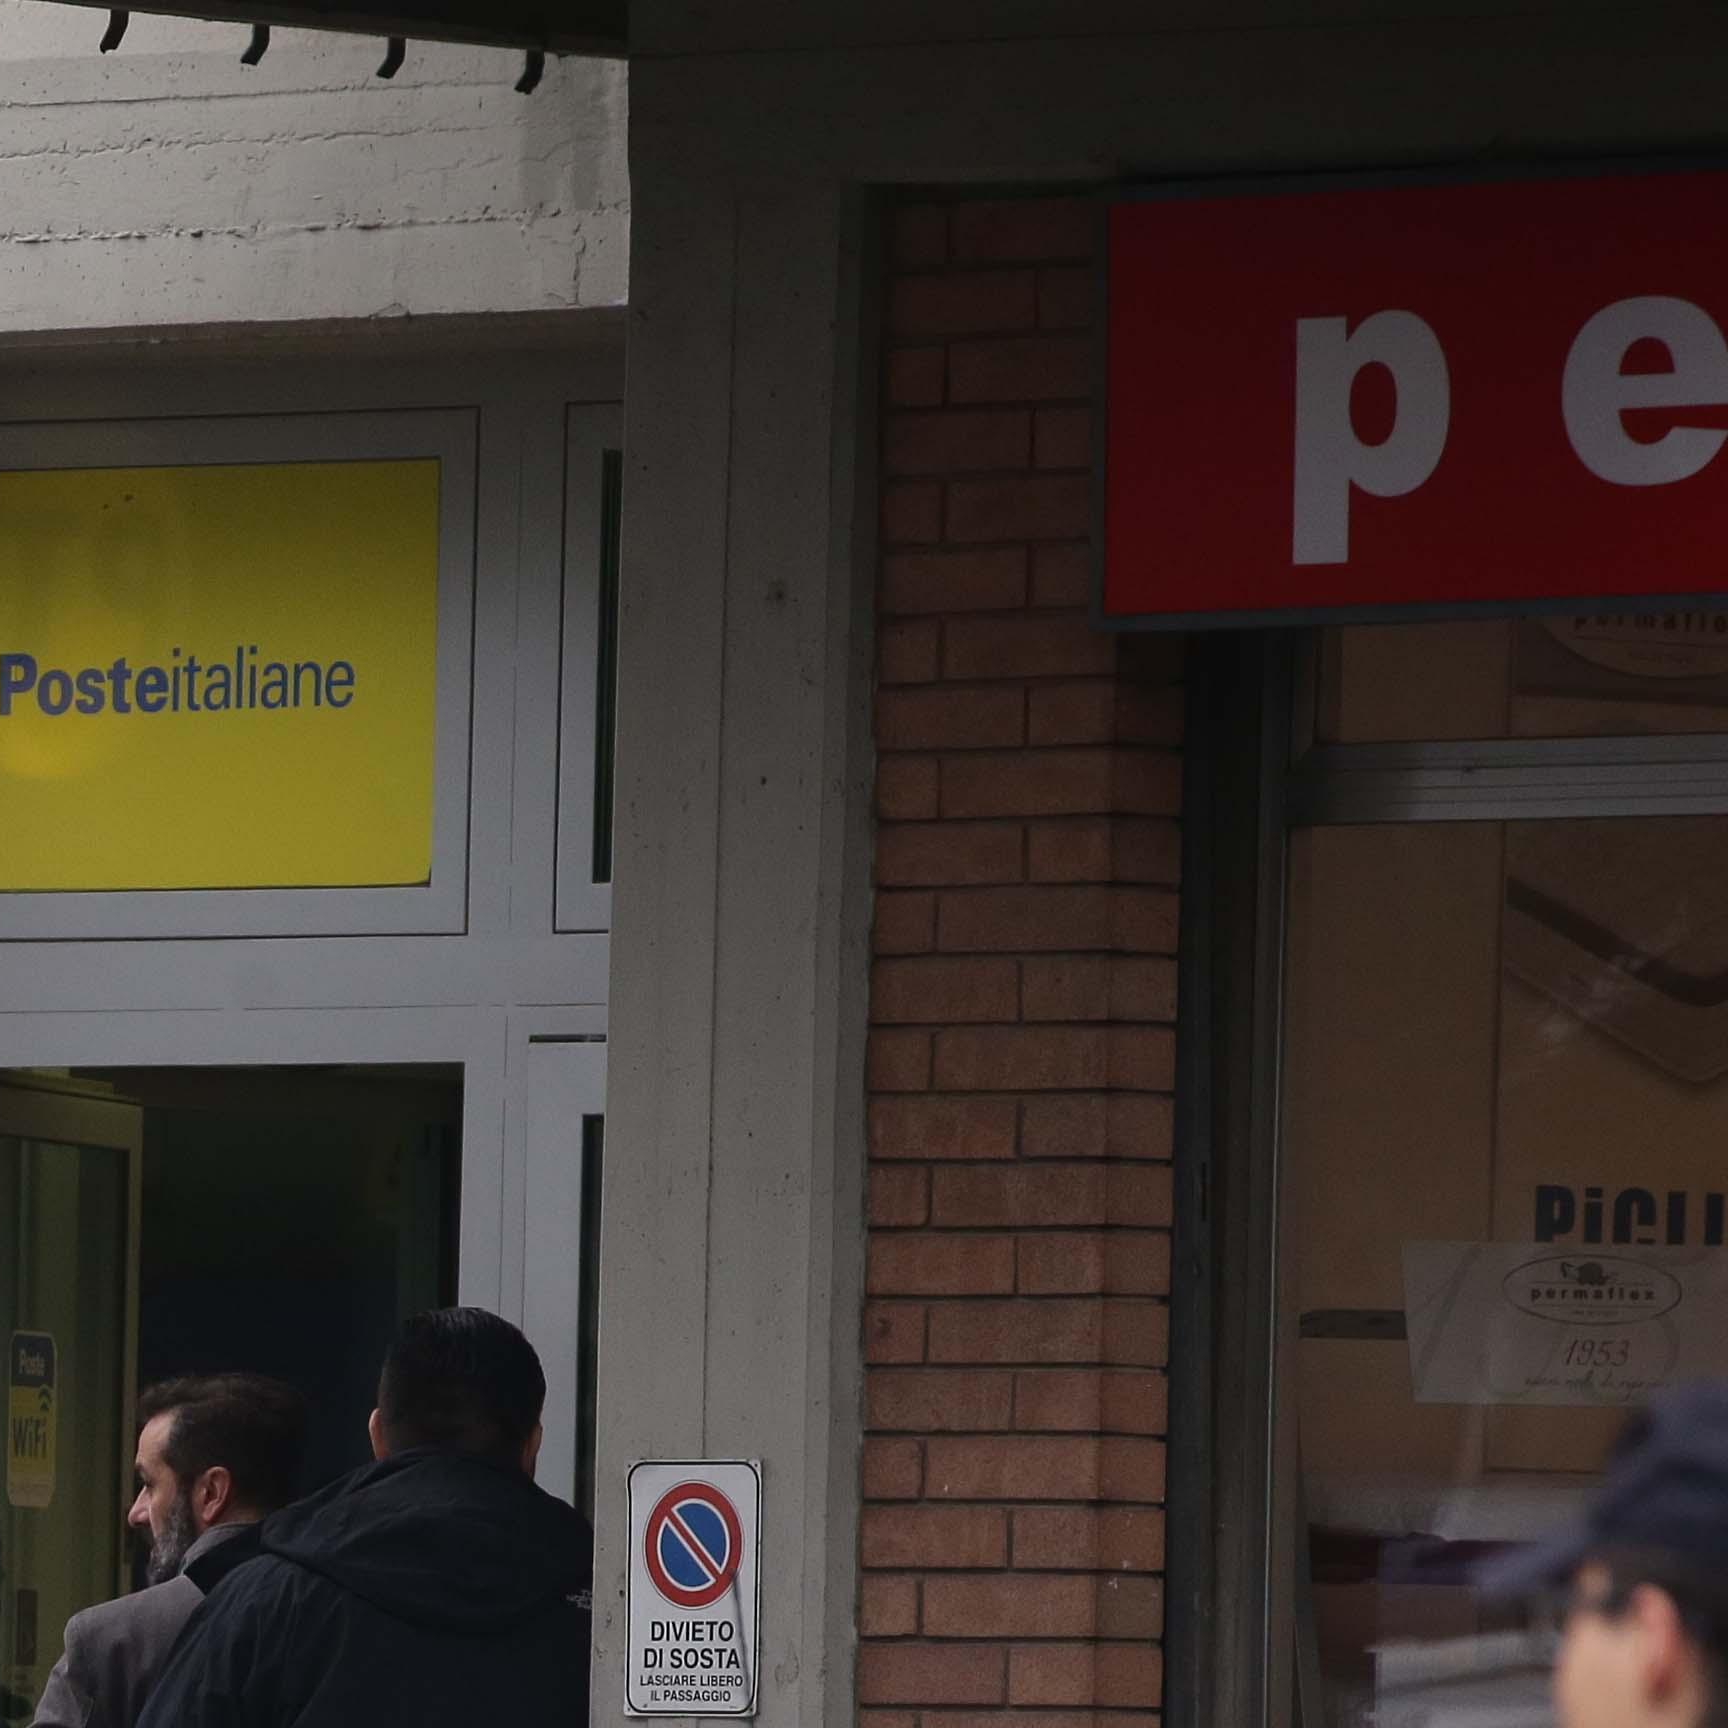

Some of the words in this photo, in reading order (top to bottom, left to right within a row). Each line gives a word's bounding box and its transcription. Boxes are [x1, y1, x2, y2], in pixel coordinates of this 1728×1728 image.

[1529, 1286, 1656, 1302] permaflex
[1563, 1338, 1632, 1368] 1953
[650, 1620, 735, 1642] DIVIETO
[643, 1647, 664, 1669] DI
[669, 1647, 741, 1669] SOSTA
[639, 1674, 697, 1687] LASCIARE
[699, 1674, 744, 1687] LIBERO
[650, 1690, 661, 1702] IL
[663, 1689, 732, 1702] PASSAGGIO
